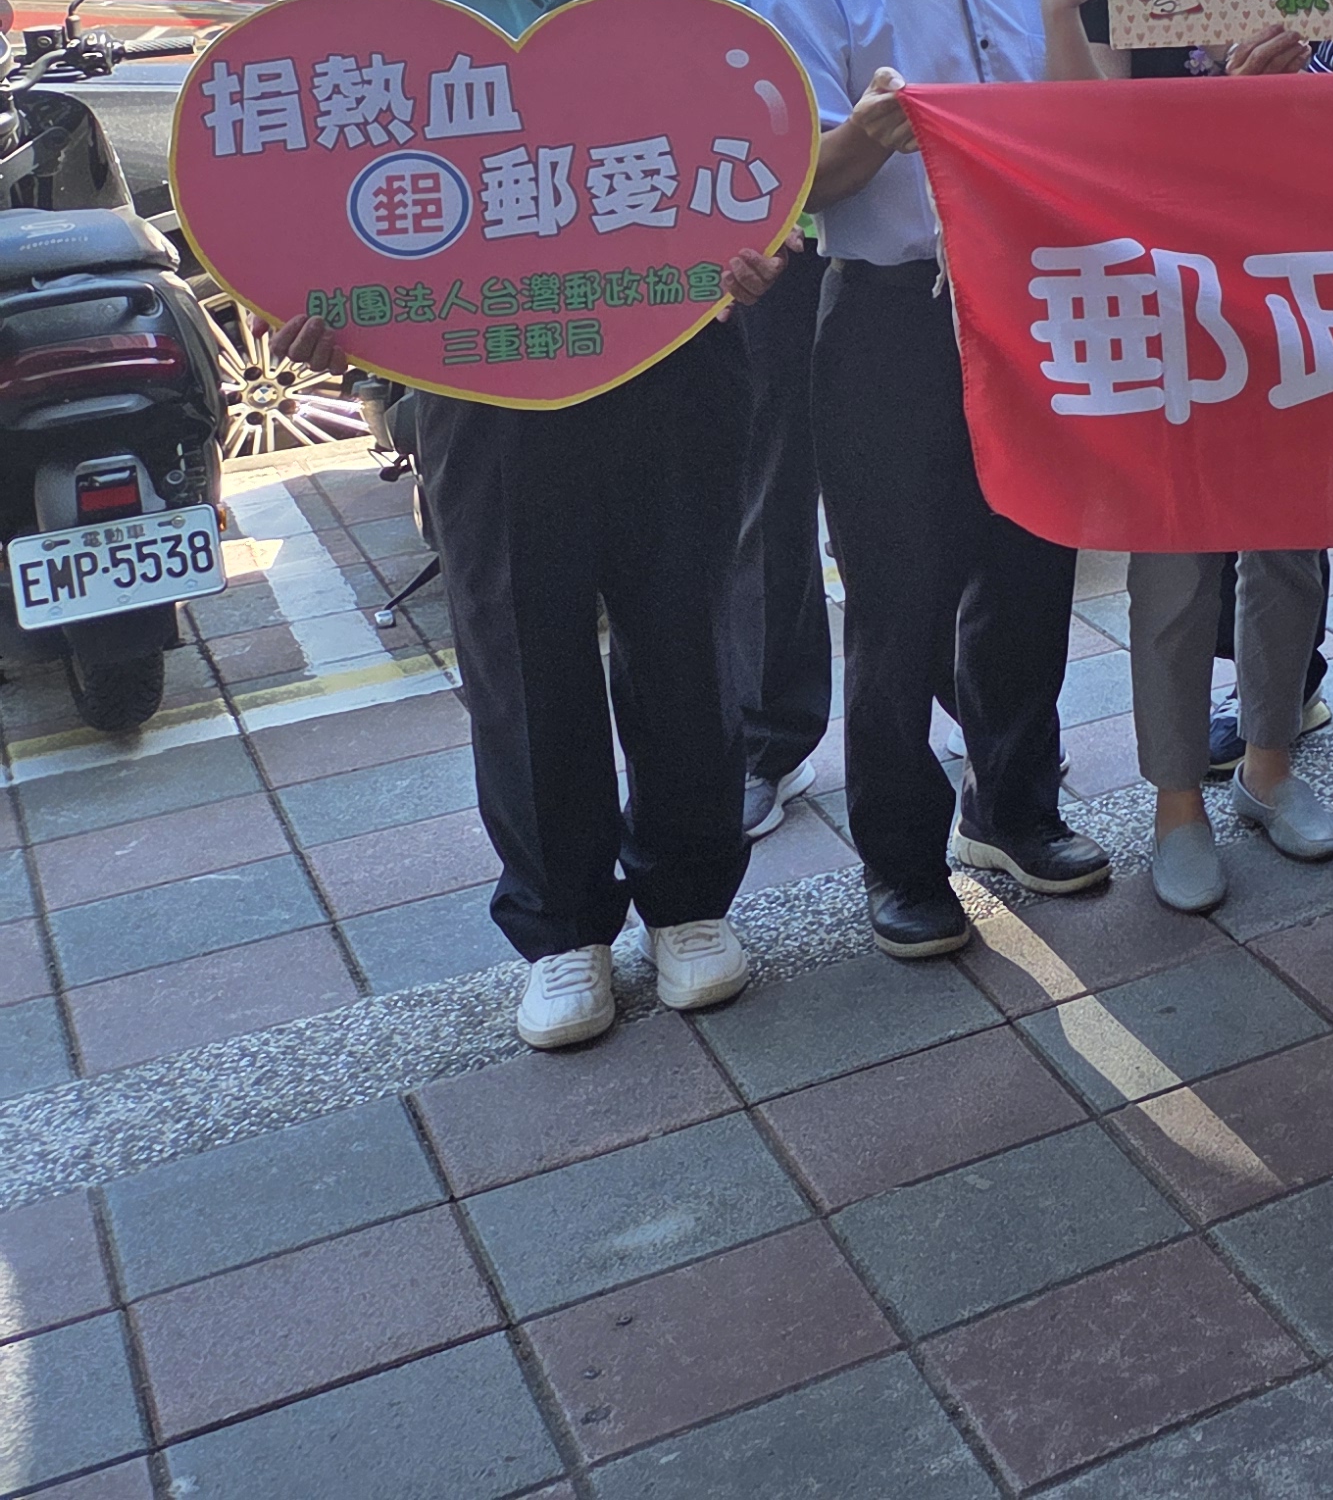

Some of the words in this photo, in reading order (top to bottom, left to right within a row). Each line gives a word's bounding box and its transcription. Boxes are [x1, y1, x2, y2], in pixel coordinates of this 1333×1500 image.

[201, 53, 523, 157] 捐熱血
[480, 135, 781, 240] 郵愛心
[306, 262, 724, 331] 財團法人台灣郵政協會
[442, 318, 604, 366] 三重郵局
[81, 523, 146, 547] 電動車
